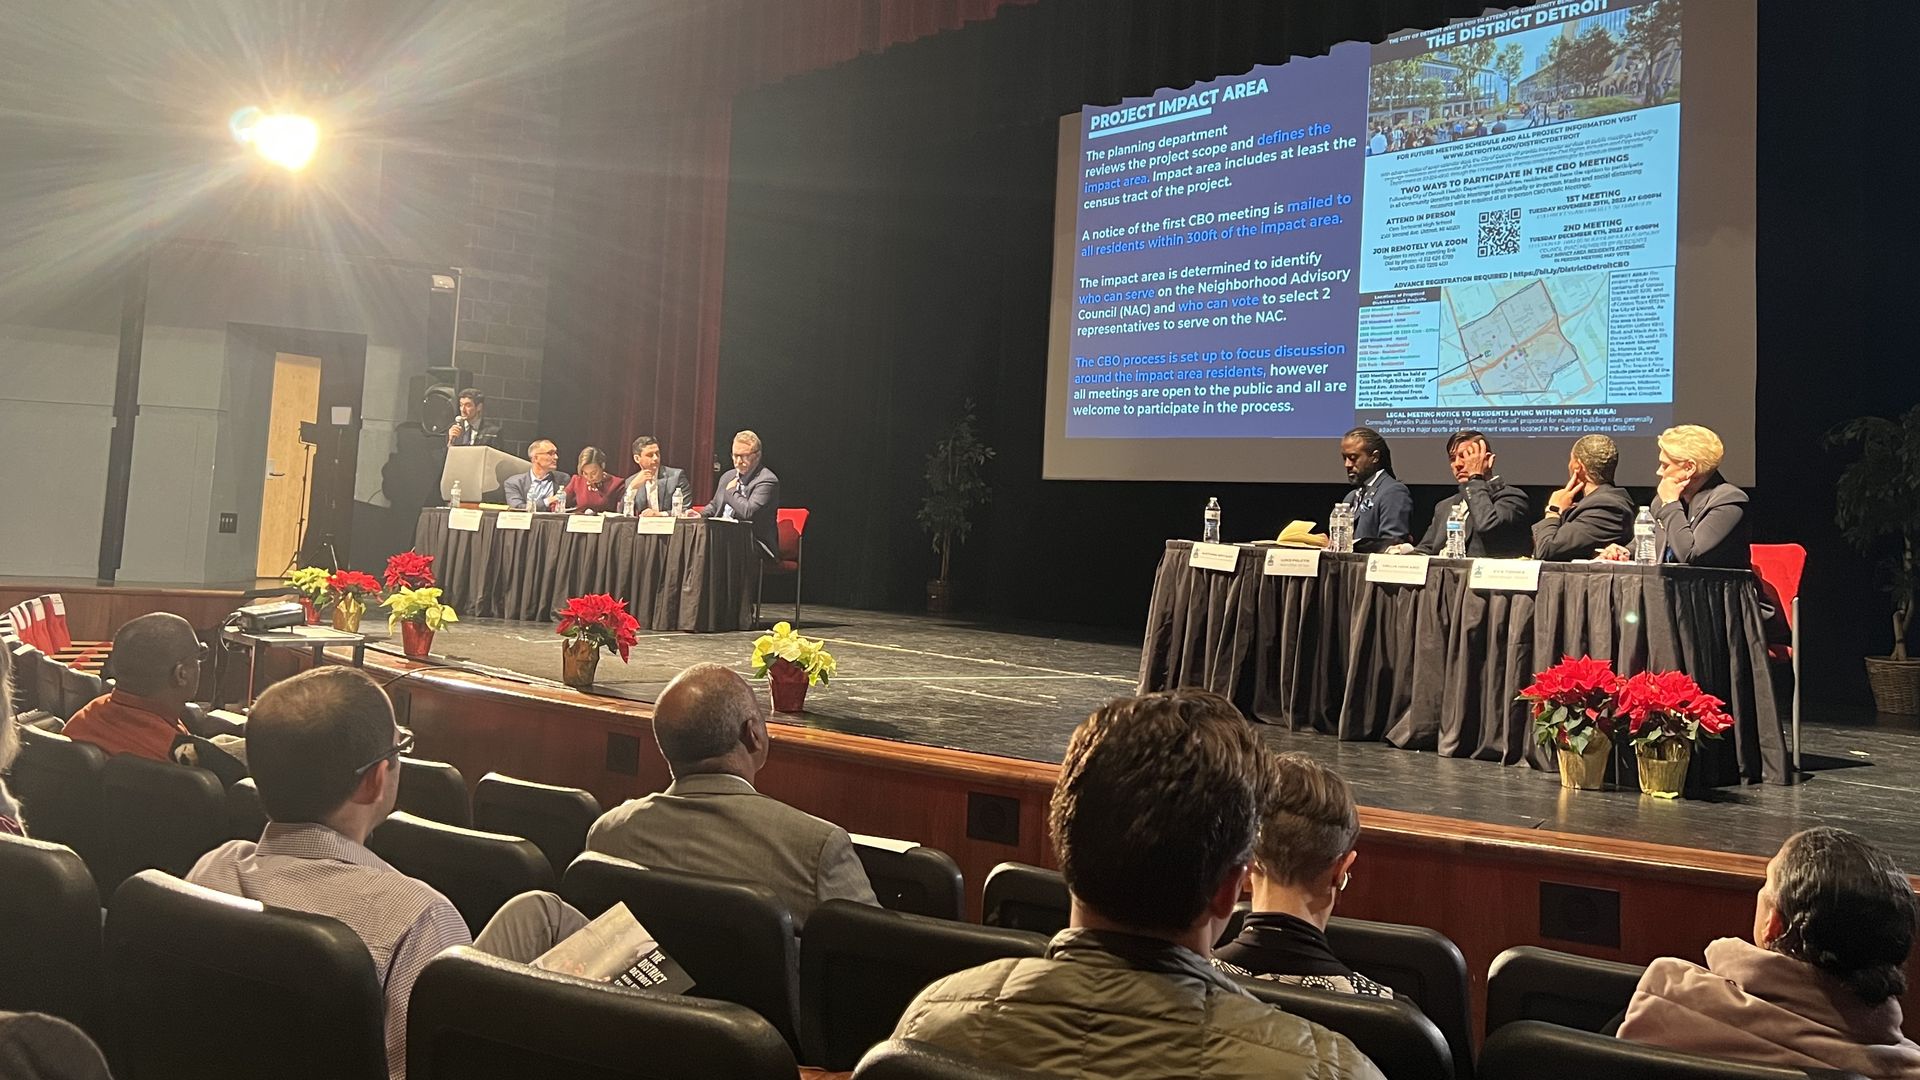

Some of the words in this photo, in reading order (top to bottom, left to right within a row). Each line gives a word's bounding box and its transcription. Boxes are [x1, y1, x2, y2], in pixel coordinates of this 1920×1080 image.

[1425, 31, 1456, 49] THE
[1459, 14, 1533, 42] DISTRICT
[1535, 0, 1608, 25] DETROIT
[1090, 102, 1156, 130] PROJECT
[1159, 88, 1219, 115] IMPACT
[1221, 78, 1268, 102] AREA
[1085, 162, 1125, 177] reviews
[1127, 157, 1146, 169] the
[1149, 149, 1189, 168] project
[1191, 143, 1227, 158] scope
[1230, 135, 1253, 151] and
[1257, 128, 1304, 145] defines
[1308, 122, 1331, 136] the
[1086, 150, 1105, 161] The
[1107, 140, 1155, 159] planning
[1158, 124, 1227, 147] department
[1410, 149, 1434, 158] FUTURE
[1435, 143, 1463, 153] MEETING
[1465, 137, 1499, 149] SCHEDULE
[1500, 135, 1516, 143] AND
[1531, 126, 1563, 137] PROJECT
[1565, 118, 1616, 132] INFORMATION
[1618, 114, 1637, 123] VISIT
[1084, 177, 1120, 193] impact
[1123, 175, 1149, 186] area.
[1152, 165, 1192, 182] Impact
[1195, 161, 1221, 174] area
[1224, 151, 1277, 169] includes
[1280, 147, 1293, 159] at
[1297, 140, 1329, 156] least
[1333, 136, 1356, 150] the
[1400, 185, 1420, 194] TWO
[1422, 181, 1447, 191] WAYS
[1449, 179, 1461, 187] TO
[1463, 169, 1520, 185] PARTICIPATE
[1522, 168, 1532, 176] IN
[1534, 165, 1553, 174] THE
[1555, 161, 1576, 171] CBO
[1579, 153, 1629, 168] MEETINGS
[1083, 196, 1119, 209] census
[1122, 189, 1148, 203] tract
[1150, 185, 1163, 198] of
[1164, 184, 1184, 196] the
[1187, 176, 1232, 195] project.
[1566, 194, 1580, 202] 1ST
[1581, 189, 1620, 200] MEETING
[1081, 230, 1090, 241] A
[1092, 225, 1125, 239] notice
[1127, 222, 1139, 234] of
[1141, 221, 1160, 232] the
[1162, 216, 1185, 230] first
[1188, 212, 1214, 226] CBO
[1217, 205, 1269, 222] meeting
[1273, 201, 1283, 214] is
[1287, 194, 1333, 212] mailed
[1336, 193, 1351, 205] to
[1386, 215, 1414, 225] ATTEND
[1425, 210, 1455, 219] PERSON
[1563, 223, 1580, 231] 2ND
[1583, 218, 1622, 229] MEETING
[1081, 245, 1093, 256] all
[1095, 240, 1144, 255] residents
[1148, 233, 1183, 248] within
[1186, 228, 1217, 243] 300ft
[1220, 225, 1234, 238] of
[1236, 224, 1257, 237] the
[1260, 217, 1306, 234] impact
[1309, 214, 1342, 227] area.
[1390, 242, 1428, 252] REMOTELY
[1430, 240, 1443, 248] VIA
[1444, 237, 1467, 246] ZOOM
[1079, 277, 1098, 288] The
[1101, 272, 1138, 287] impact
[1141, 271, 1165, 282] area
[1168, 267, 1177, 279] is
[1180, 259, 1250, 278] determined
[1253, 259, 1267, 269] to
[1271, 251, 1322, 268] identify
[1394, 280, 1424, 288] ADVANCE
[1425, 275, 1472, 285] REGISTRATION
[1473, 272, 1508, 280] REQUIRED
[1078, 292, 1101, 304] who
[1103, 292, 1122, 302] can
[1124, 289, 1154, 300] serve
[1157, 287, 1172, 297] on
[1175, 283, 1194, 295] the
[1198, 272, 1287, 293] Neighborhood
[1290, 268, 1351, 284] Advisory
[1078, 305, 1116, 320] Council
[1119, 303, 1150, 318] (NAC)
[1153, 301, 1175, 313] and
[1178, 299, 1203, 311] who
[1206, 299, 1228, 309] can
[1231, 295, 1259, 307] vote
[1262, 293, 1276, 304] to
[1279, 288, 1318, 303] select
[1322, 287, 1330, 299] 2
[1077, 319, 1160, 337] representatives
[1163, 319, 1175, 329] to
[1177, 317, 1209, 328] serve
[1212, 316, 1227, 326] on
[1230, 312, 1252, 325] the
[1255, 309, 1286, 323] NAC.
[1075, 357, 1094, 367] The
[1096, 355, 1120, 366] CBO
[1123, 355, 1165, 367] process
[1168, 351, 1177, 363] is
[1180, 351, 1198, 362] set
[1202, 352, 1217, 363] up
[1220, 349, 1233, 360] to
[1236, 347, 1270, 359] focus
[1274, 342, 1344, 357] discussion
[1074, 371, 1111, 383] around
[1114, 370, 1132, 382] the
[1135, 369, 1174, 383] impact
[1177, 369, 1202, 379] area
[1206, 365, 1266, 378] residents,
[1270, 363, 1328, 376] however
[1073, 388, 1085, 399] all
[1088, 386, 1138, 400] meetings
[1141, 388, 1159, 397] are
[1161, 387, 1191, 399] open
[1193, 385, 1206, 396] to
[1209, 383, 1230, 395] the
[1233, 381, 1273, 397] public
[1276, 380, 1301, 393] and
[1304, 380, 1320, 392] all
[1324, 382, 1347, 392] are
[1072, 404, 1120, 415] welcome
[1123, 404, 1134, 414] to
[1137, 401, 1199, 416] participate
[1202, 400, 1214, 413] in
[1216, 400, 1238, 413] the
[1241, 401, 1294, 415] process.
[637, 958, 668, 985] DISTRICT
[648, 950, 666, 965] THE
[628, 966, 653, 987] DETROIT
